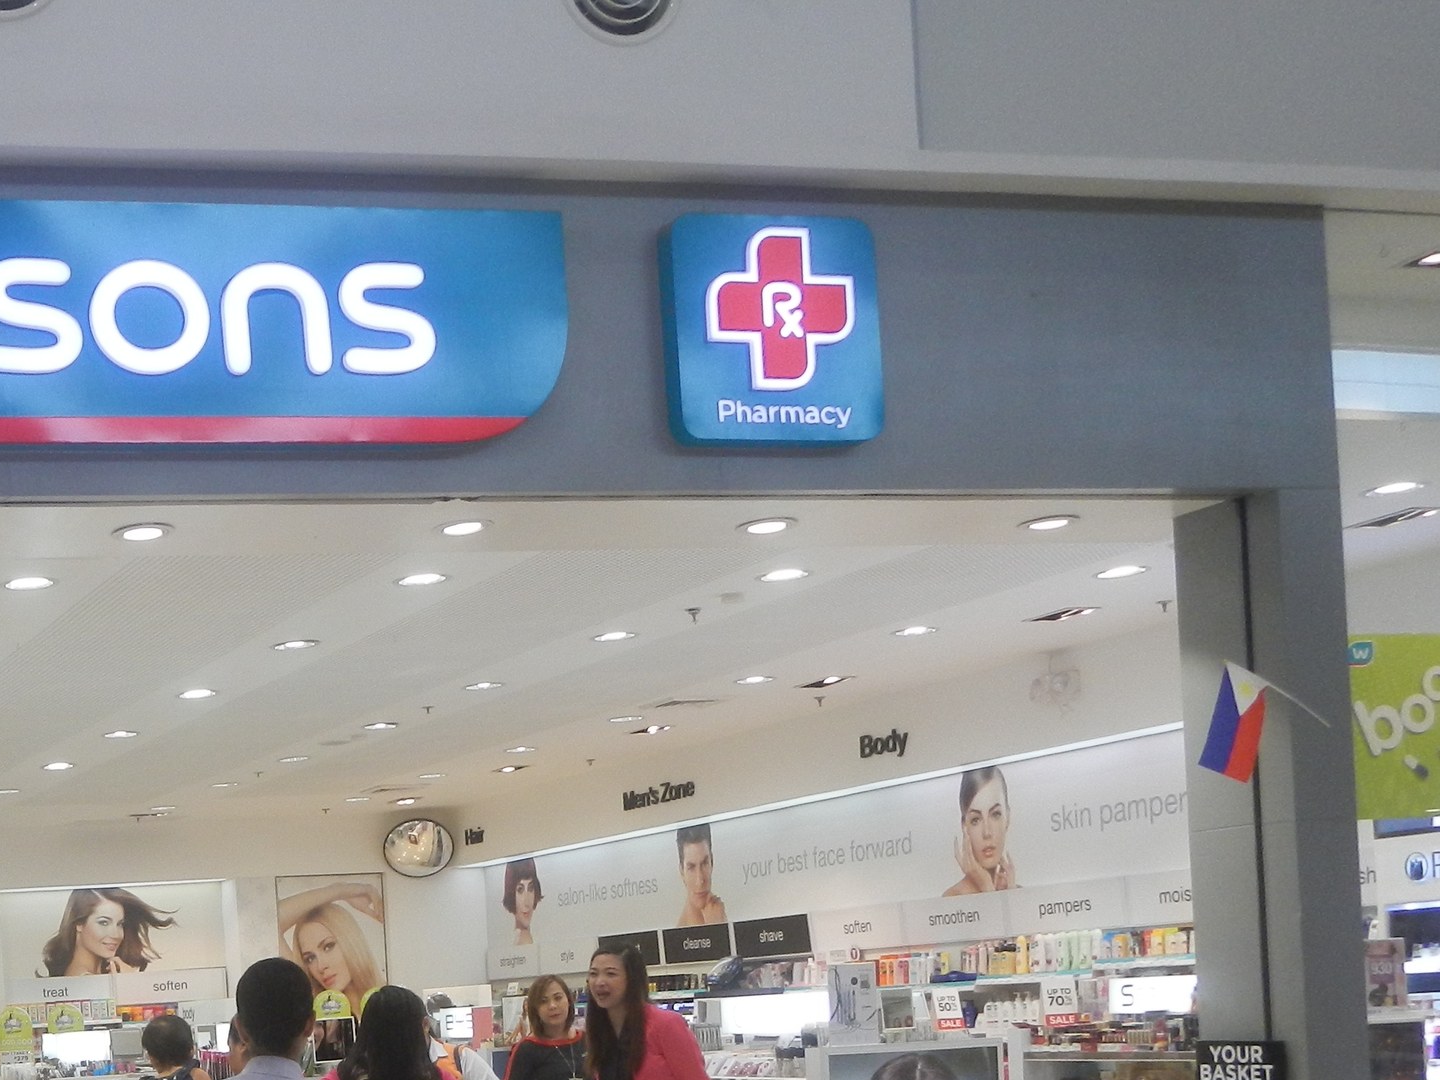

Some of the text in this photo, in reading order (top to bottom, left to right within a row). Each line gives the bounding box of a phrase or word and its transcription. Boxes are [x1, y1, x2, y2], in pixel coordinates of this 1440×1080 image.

[717, 399, 852, 428] Pharmacy
[1353, 666, 1440, 757] boo
[859, 729, 908, 758] Body
[622, 780, 695, 811] Men's Zone
[1050, 791, 1188, 832] skin pamper
[464, 827, 485, 846] Hair
[742, 831, 913, 885] your best face forward
[558, 877, 659, 907] salon-like softness
[1159, 887, 1192, 905] mois
[1038, 898, 1092, 919] pampers
[843, 920, 872, 934] soften
[929, 909, 980, 927] smoothen
[683, 936, 712, 950] cleanse
[759, 930, 784, 943] shave
[499, 955, 527, 967] straighten
[560, 949, 575, 961] style
[43, 987, 68, 998] treat
[153, 980, 188, 992] soften
[940, 1019, 962, 1028] SALE
[1049, 1015, 1075, 1025] SALE
[1209, 1045, 1263, 1063] YOUR
